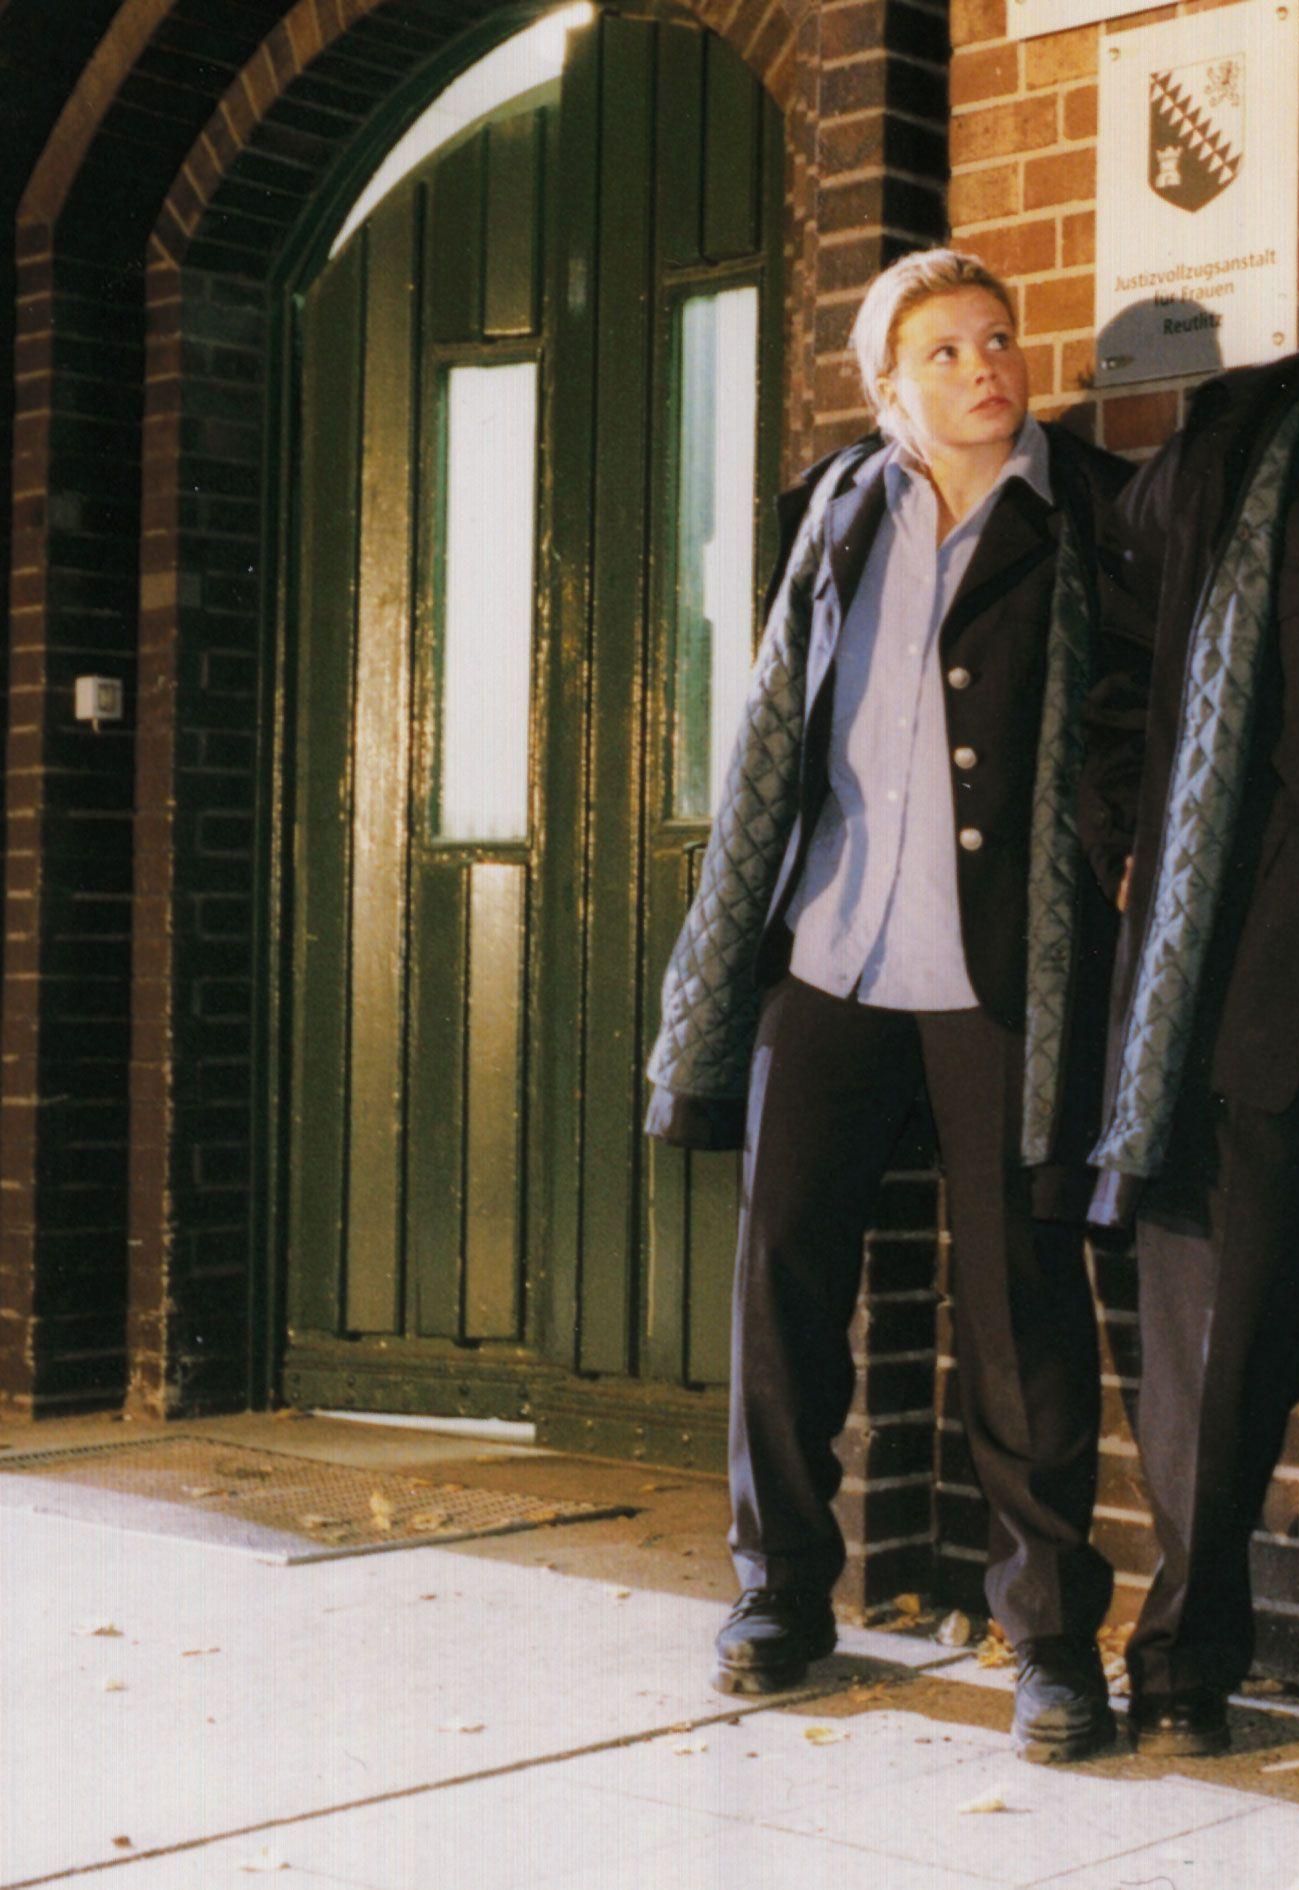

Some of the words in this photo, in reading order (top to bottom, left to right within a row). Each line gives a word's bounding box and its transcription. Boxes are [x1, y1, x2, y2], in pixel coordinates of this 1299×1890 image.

[1114, 249, 1276, 292] Justizvollzugsanstalt
[1181, 281, 1235, 304] Frauen
[1163, 310, 1223, 335] Reutlitz
